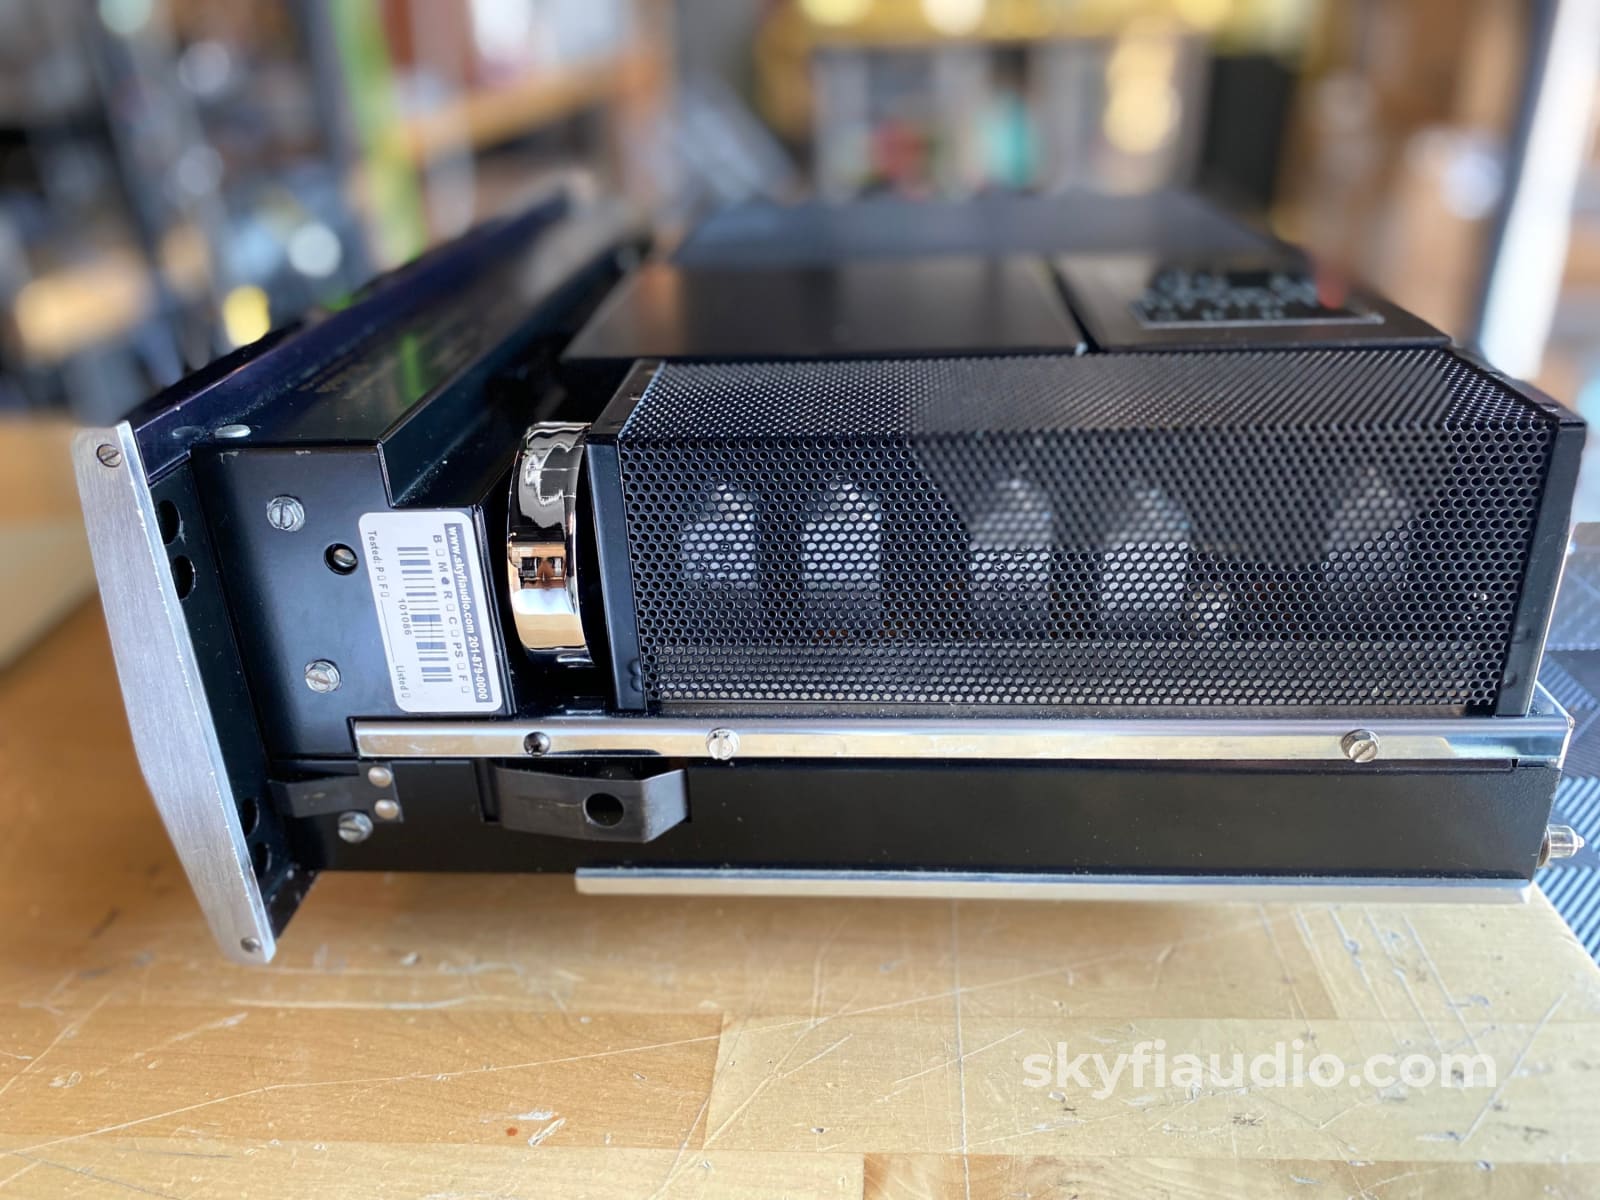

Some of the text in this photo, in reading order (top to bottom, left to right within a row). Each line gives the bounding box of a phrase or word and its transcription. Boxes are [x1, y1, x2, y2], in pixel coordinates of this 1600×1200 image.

[433, 535, 442, 543] B
[438, 562, 448, 572] M
[443, 591, 453, 599] R
[367, 531, 382, 564] Tested:
[396, 665, 408, 690] Listed
[398, 599, 411, 635] 101086
[448, 527, 488, 699] www.skyfiaudio.com 201-879-0000
[449, 617, 458, 625] C
[452, 642, 464, 658] PS
